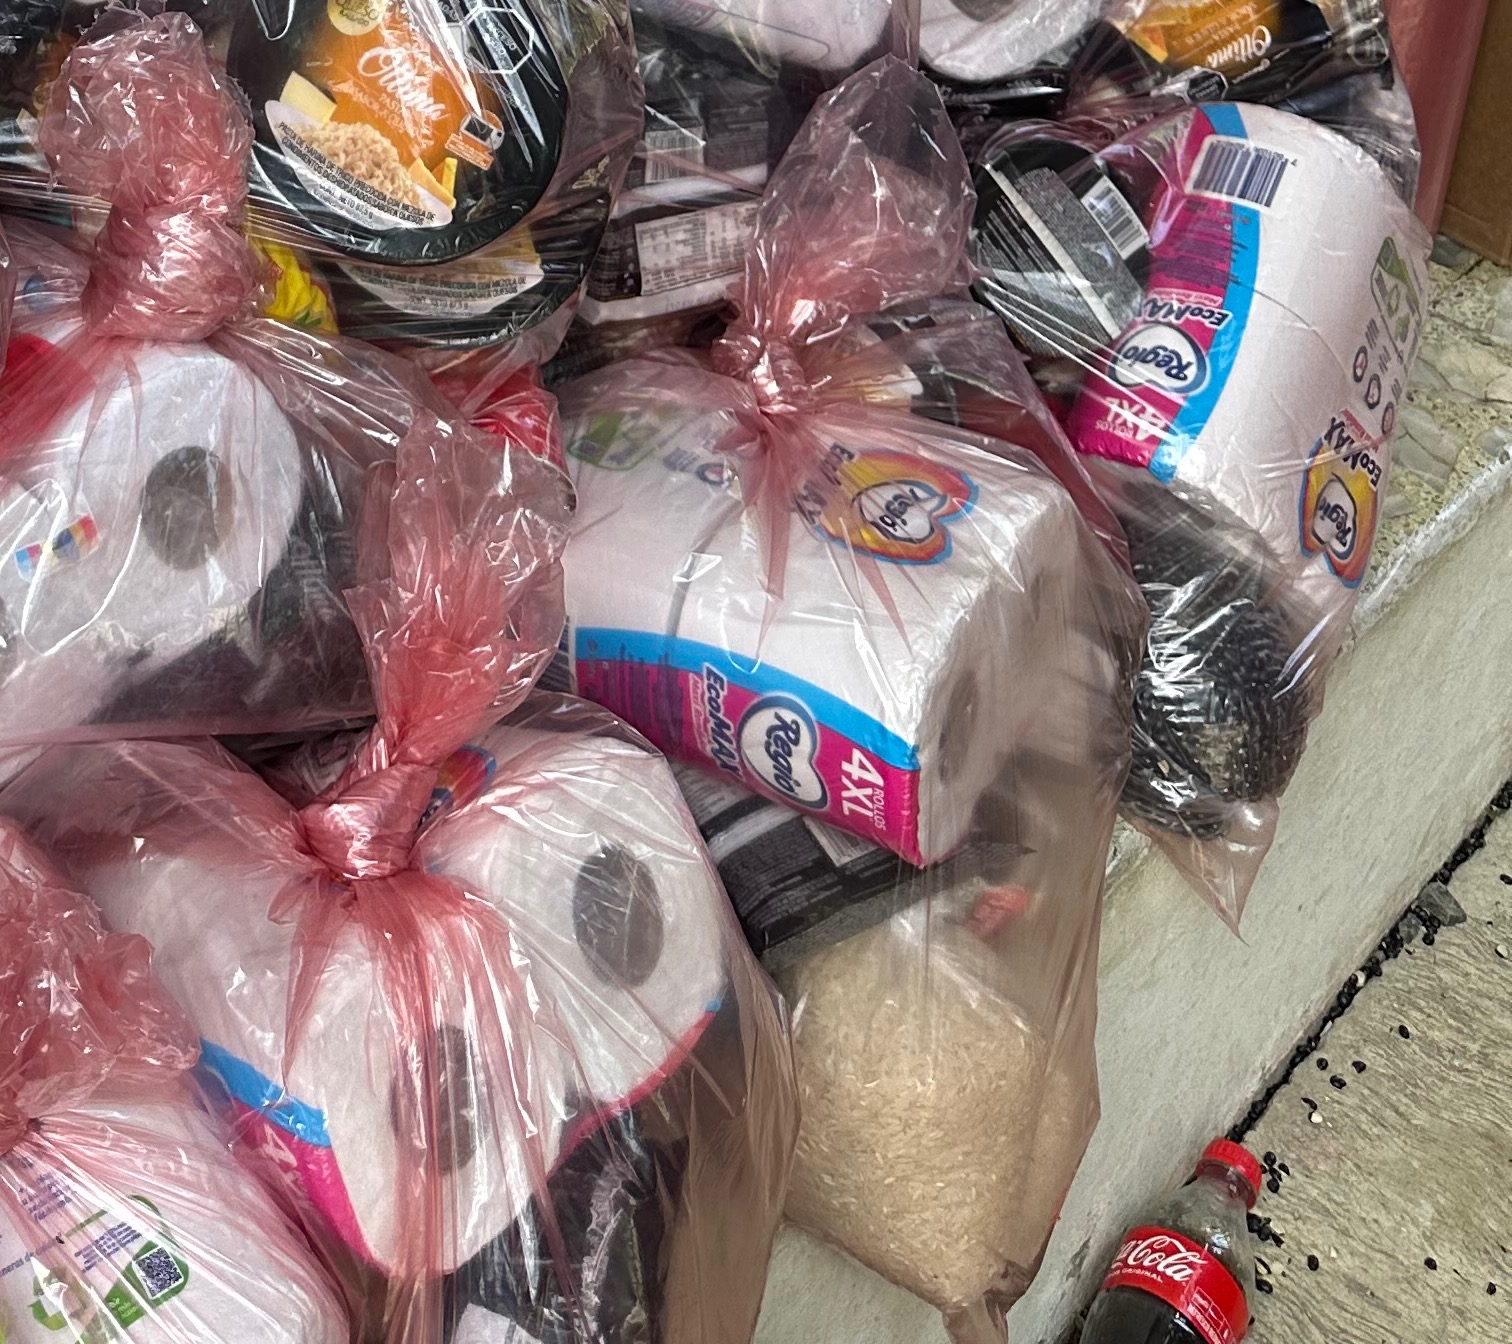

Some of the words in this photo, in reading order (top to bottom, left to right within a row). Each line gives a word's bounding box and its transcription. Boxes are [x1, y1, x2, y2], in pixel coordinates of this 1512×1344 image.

[1207, 25, 1272, 69] Ottima
[1140, 296, 1232, 328] EcoMA
[1123, 342, 1192, 383] Regio
[1105, 397, 1165, 442] 4XL
[1320, 416, 1383, 492] EcoMAX
[1317, 497, 1351, 550] Regio
[702, 663, 737, 777] EcoMAX
[771, 712, 802, 802] Regio
[841, 749, 885, 819] 4XL
[872, 788, 887, 830] ROLLOS
[1122, 1268, 1164, 1283] ORIGINAL
